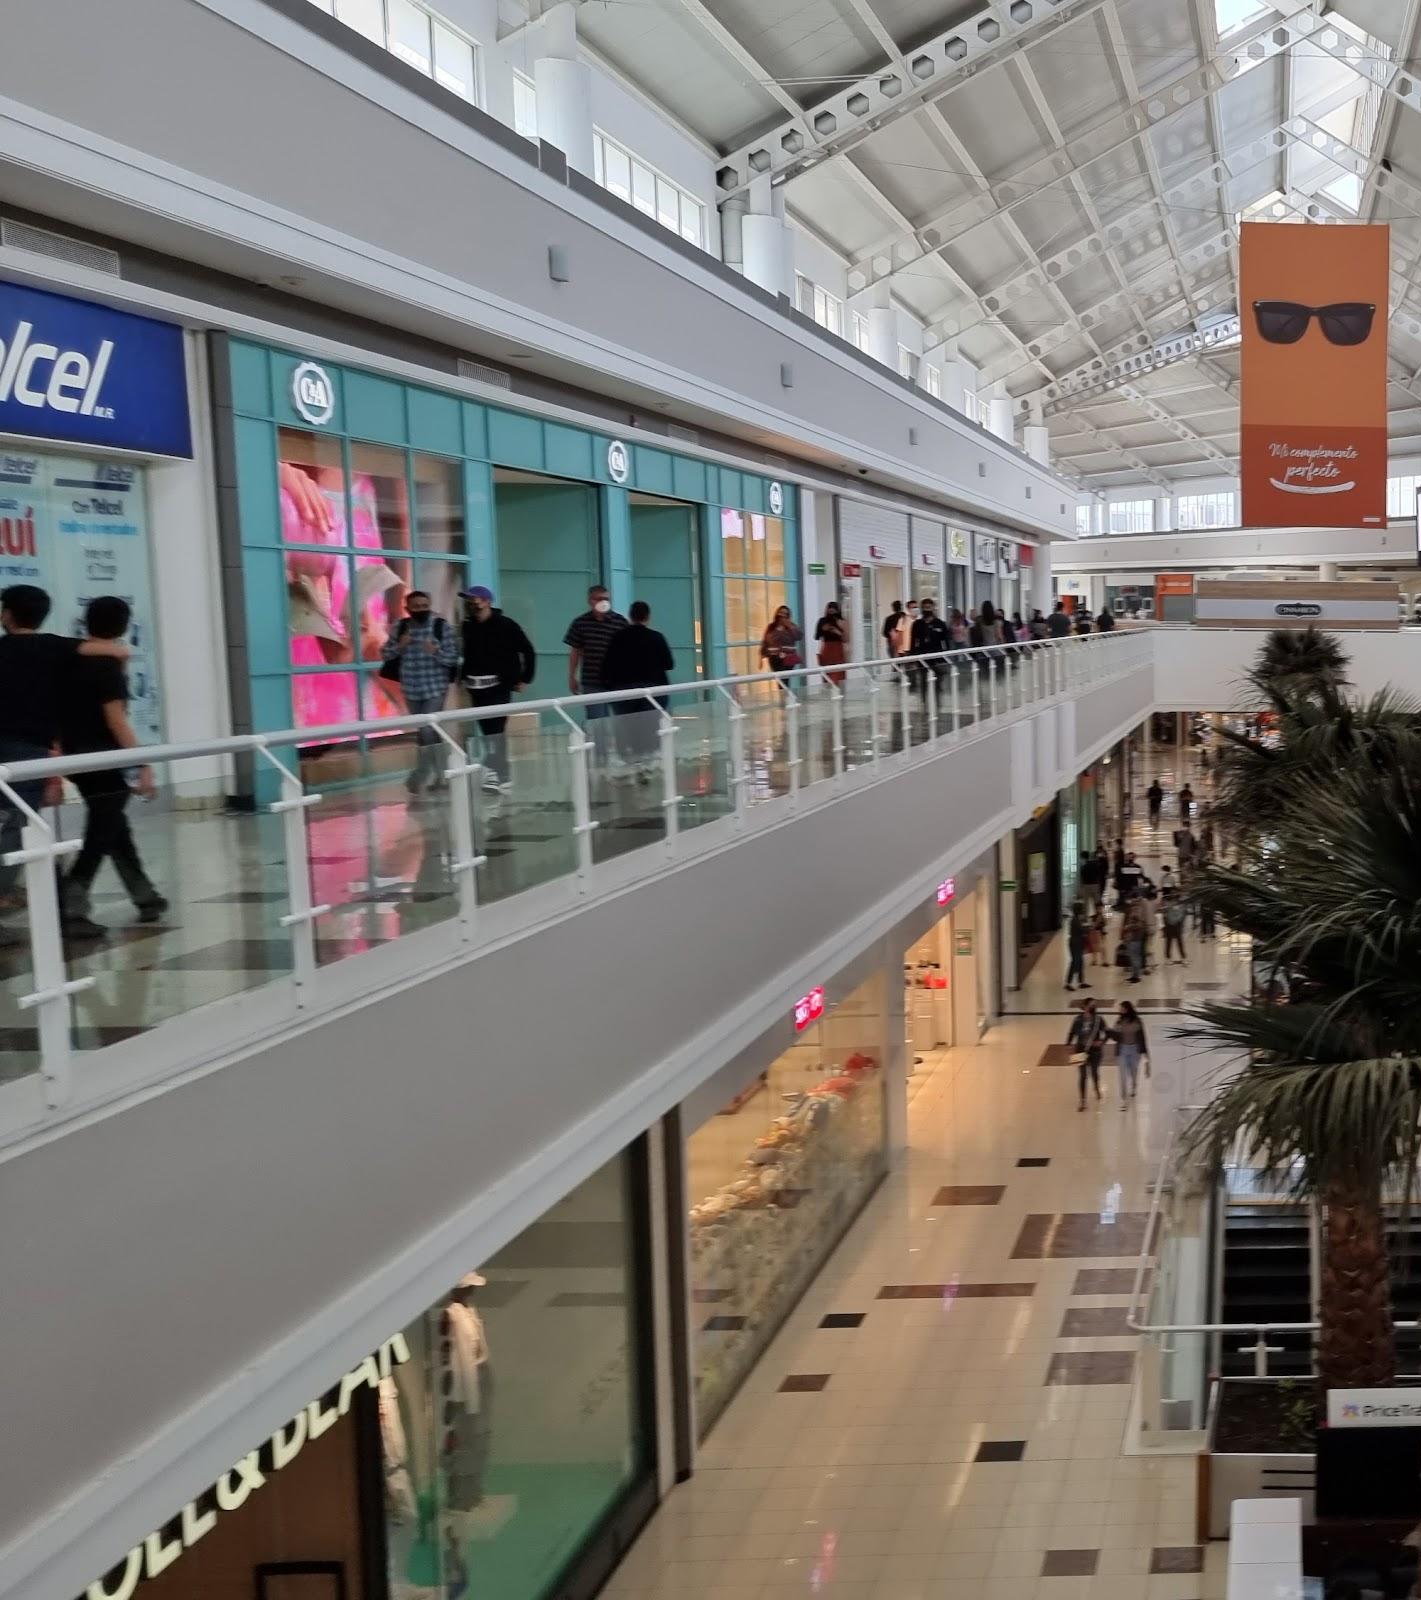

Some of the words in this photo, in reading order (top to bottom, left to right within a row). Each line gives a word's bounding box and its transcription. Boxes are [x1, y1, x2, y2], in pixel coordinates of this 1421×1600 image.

[0, 321, 114, 416] lcel
[1269, 443, 1288, 457] Mi
[1289, 445, 1359, 464] complemento
[1283, 460, 1341, 483] perfecto
